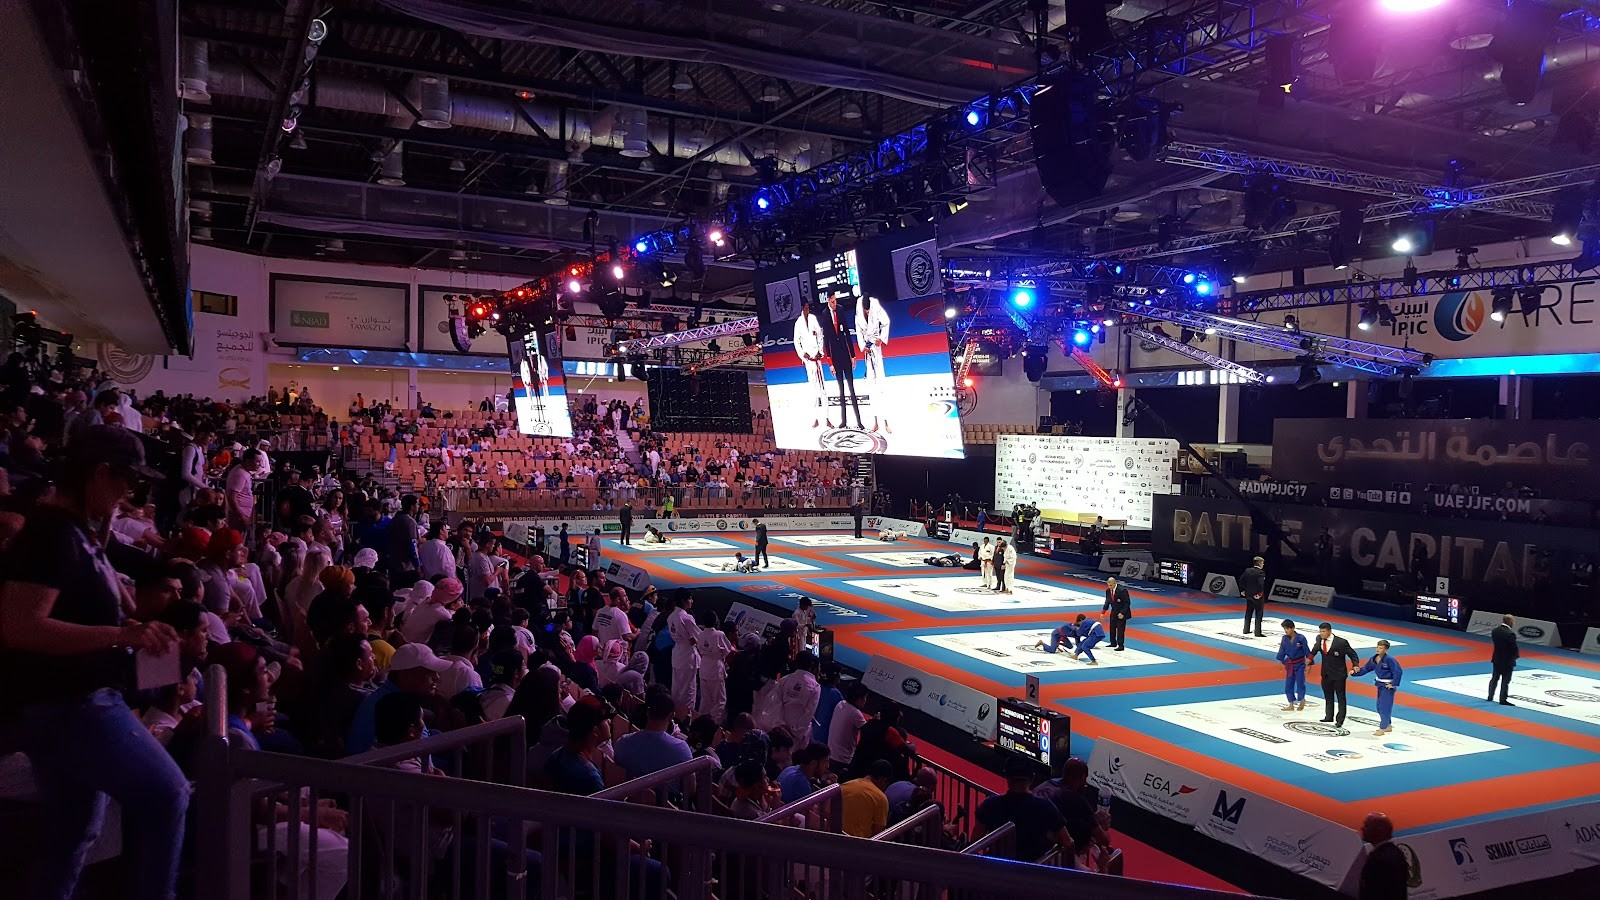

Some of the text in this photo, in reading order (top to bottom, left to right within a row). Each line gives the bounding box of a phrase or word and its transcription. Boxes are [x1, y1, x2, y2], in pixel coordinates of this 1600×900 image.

[802, 281, 808, 294] 5
[302, 317, 327, 326] NBAD
[350, 324, 391, 332] TAWAZUN
[1392, 321, 1428, 337] IPIC
[587, 336, 607, 345] IPIC
[728, 340, 745, 348] EGA
[217, 342, 254, 353] للجميع
[1317, 427, 1591, 472] عاصمة التحدي
[1238, 481, 1307, 497] #ADWPJJC17
[1434, 494, 1531, 514] UAEJJF.COM
[1439, 581, 1446, 590] 3
[1452, 599, 1459, 608] 0
[1452, 608, 1459, 617] 0
[904, 685, 918, 693] ROVER
[906, 679, 918, 688] LAND
[1029, 683, 1036, 699] 2
[1042, 719, 1049, 734] 0
[1041, 736, 1048, 750] 0
[1143, 772, 1170, 795] EGA
[1264, 842, 1292, 857] ENERGY
[1266, 835, 1297, 852] DOLPHIN
